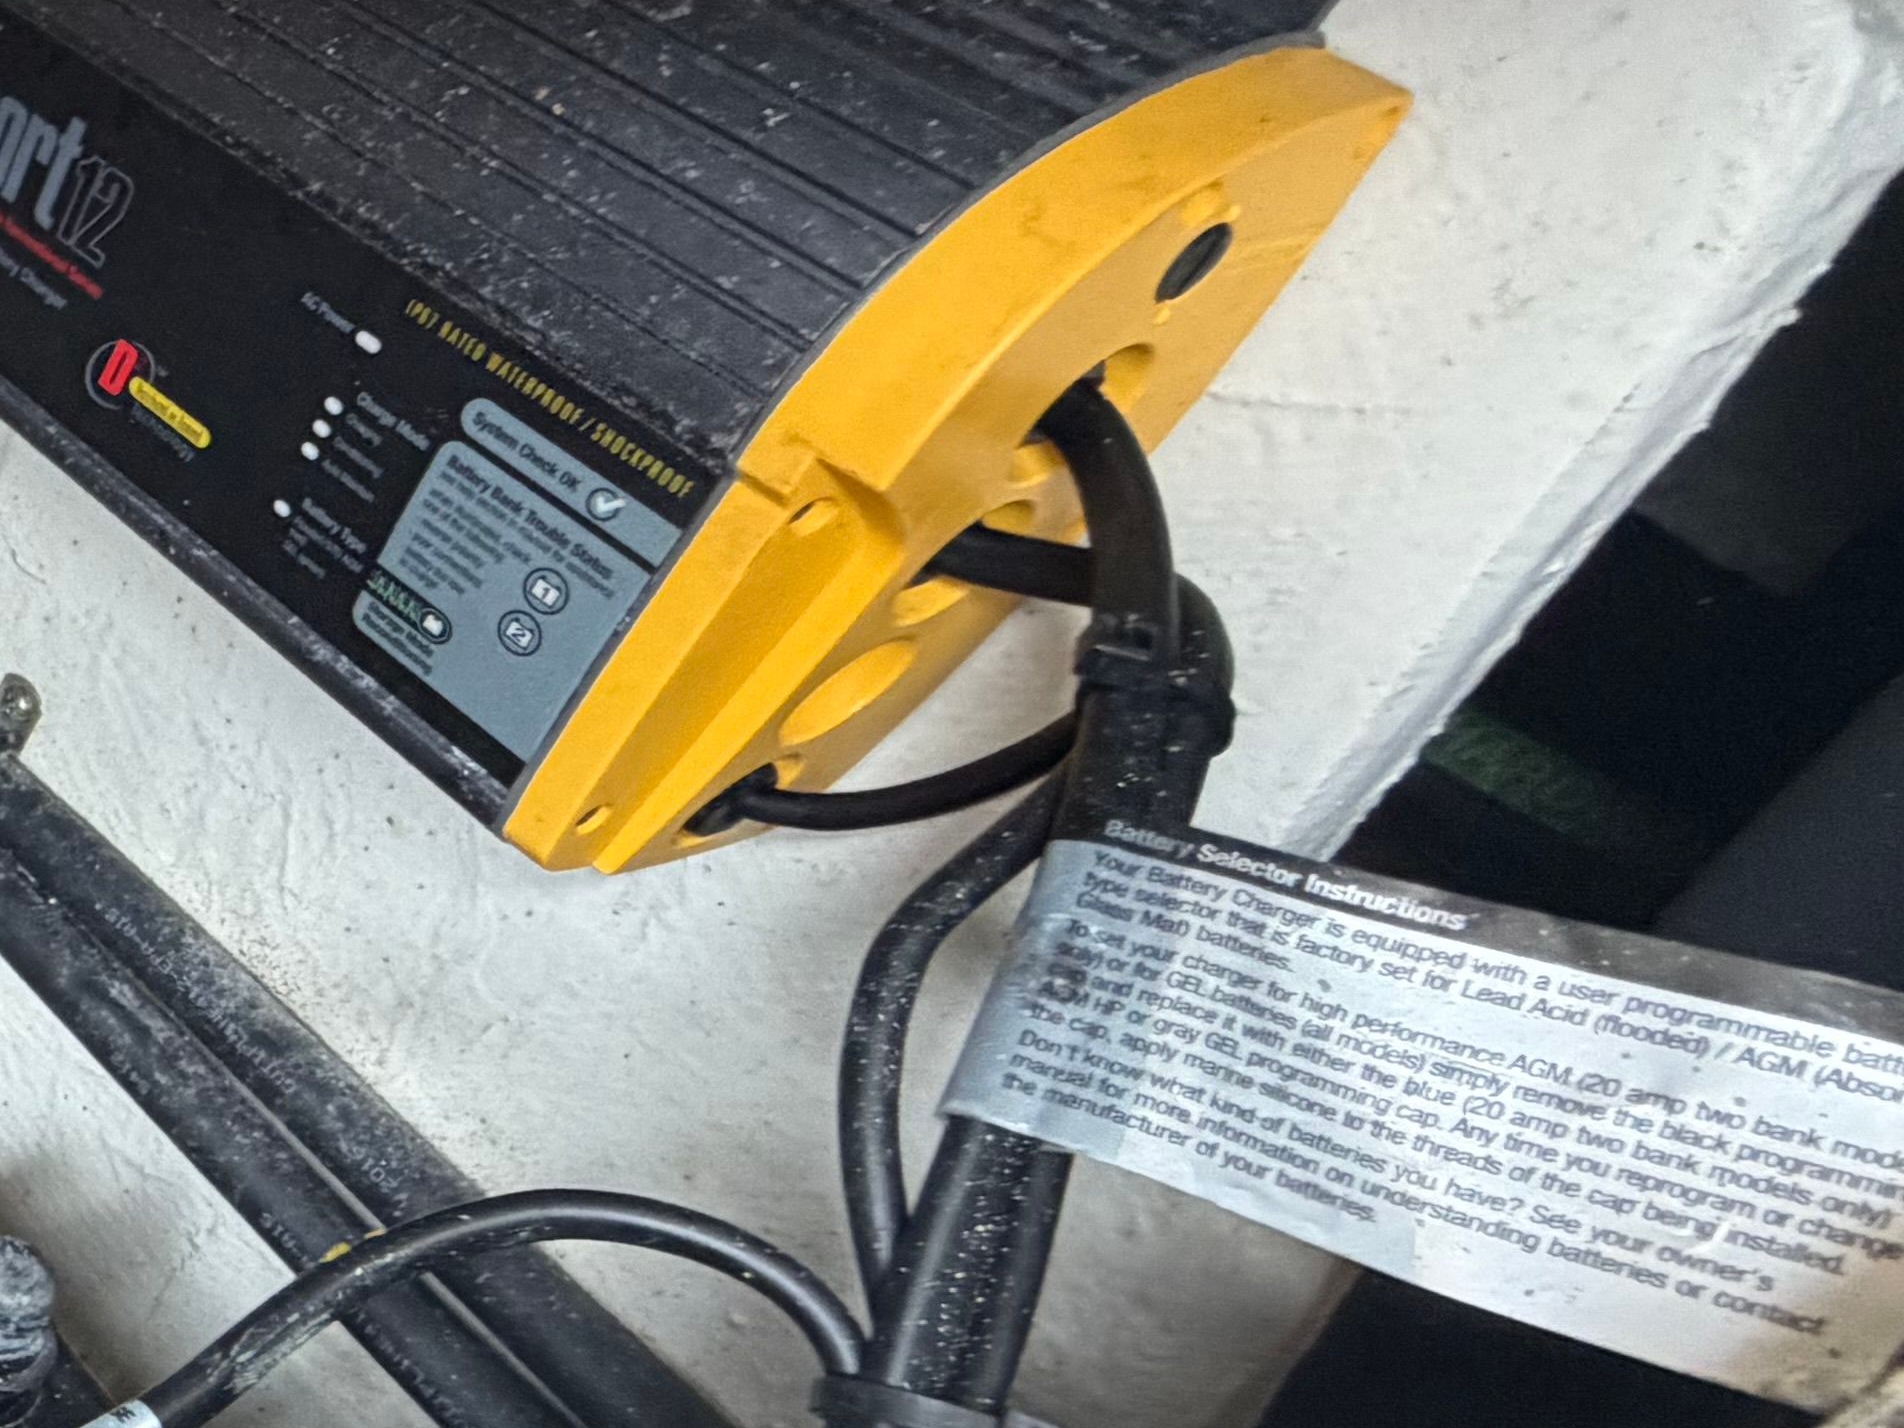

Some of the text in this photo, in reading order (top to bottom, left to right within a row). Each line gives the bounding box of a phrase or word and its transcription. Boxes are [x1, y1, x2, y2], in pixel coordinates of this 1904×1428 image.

[56, 154, 135, 269] 12
[437, 319, 488, 364] RATED
[483, 350, 584, 428] WATERPROOF
[589, 422, 693, 501] SHOCKPROOF
[468, 410, 582, 493] System Check OK
[442, 453, 614, 581] Battery Bank Trouble Status
[1099, 816, 1467, 931] Battery Selector Instructions
[1091, 849, 1835, 1063] Your Battery Charger is equipped with a user programmable
[1272, 925, 1809, 1080] is factory set for Lead Acid (flooded) AGM
[1181, 950, 1824, 1152] charger for high performance AGM two bank
[1334, 1030, 1730, 1156] models) simply remove the black
[1194, 1135, 1268, 1184] of your
[1360, 1063, 1698, 1176] the blue (20 amp two bank
[1447, 1116, 1610, 1187] Any you
[1508, 1162, 1536, 1187] of
[1358, 1174, 1668, 1290] understanding batteries
[1390, 1165, 1651, 1263] you have? See your
